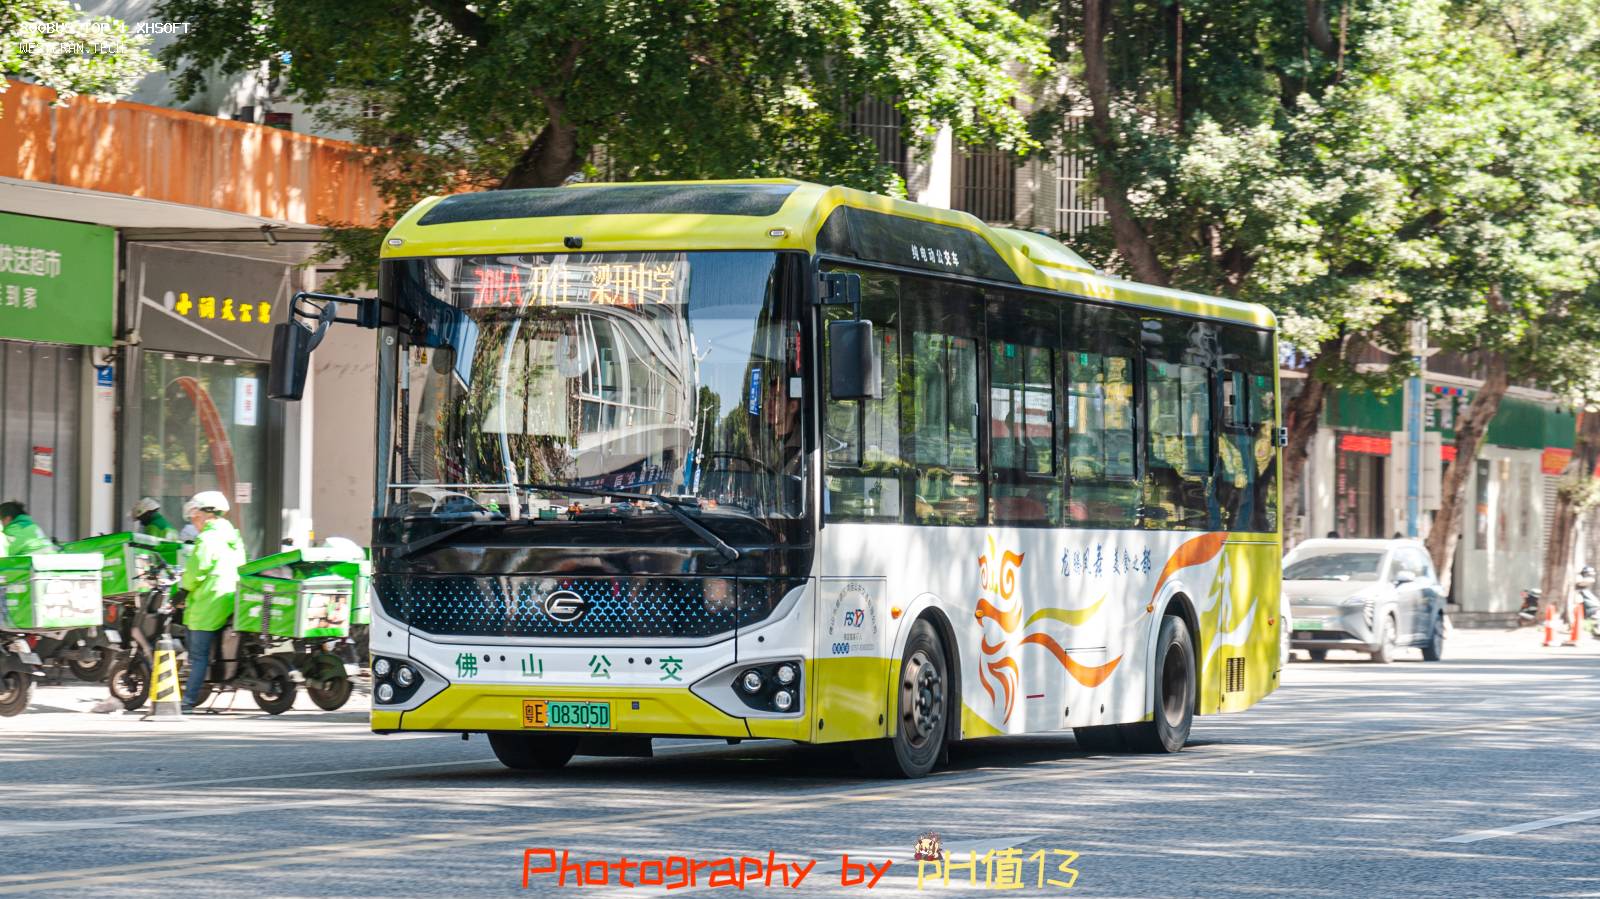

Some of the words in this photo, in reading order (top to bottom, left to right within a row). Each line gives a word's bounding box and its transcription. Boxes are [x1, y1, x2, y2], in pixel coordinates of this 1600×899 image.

[911, 243, 960, 267] 纯电动公交车
[455, 652, 684, 682] 佛山公交
